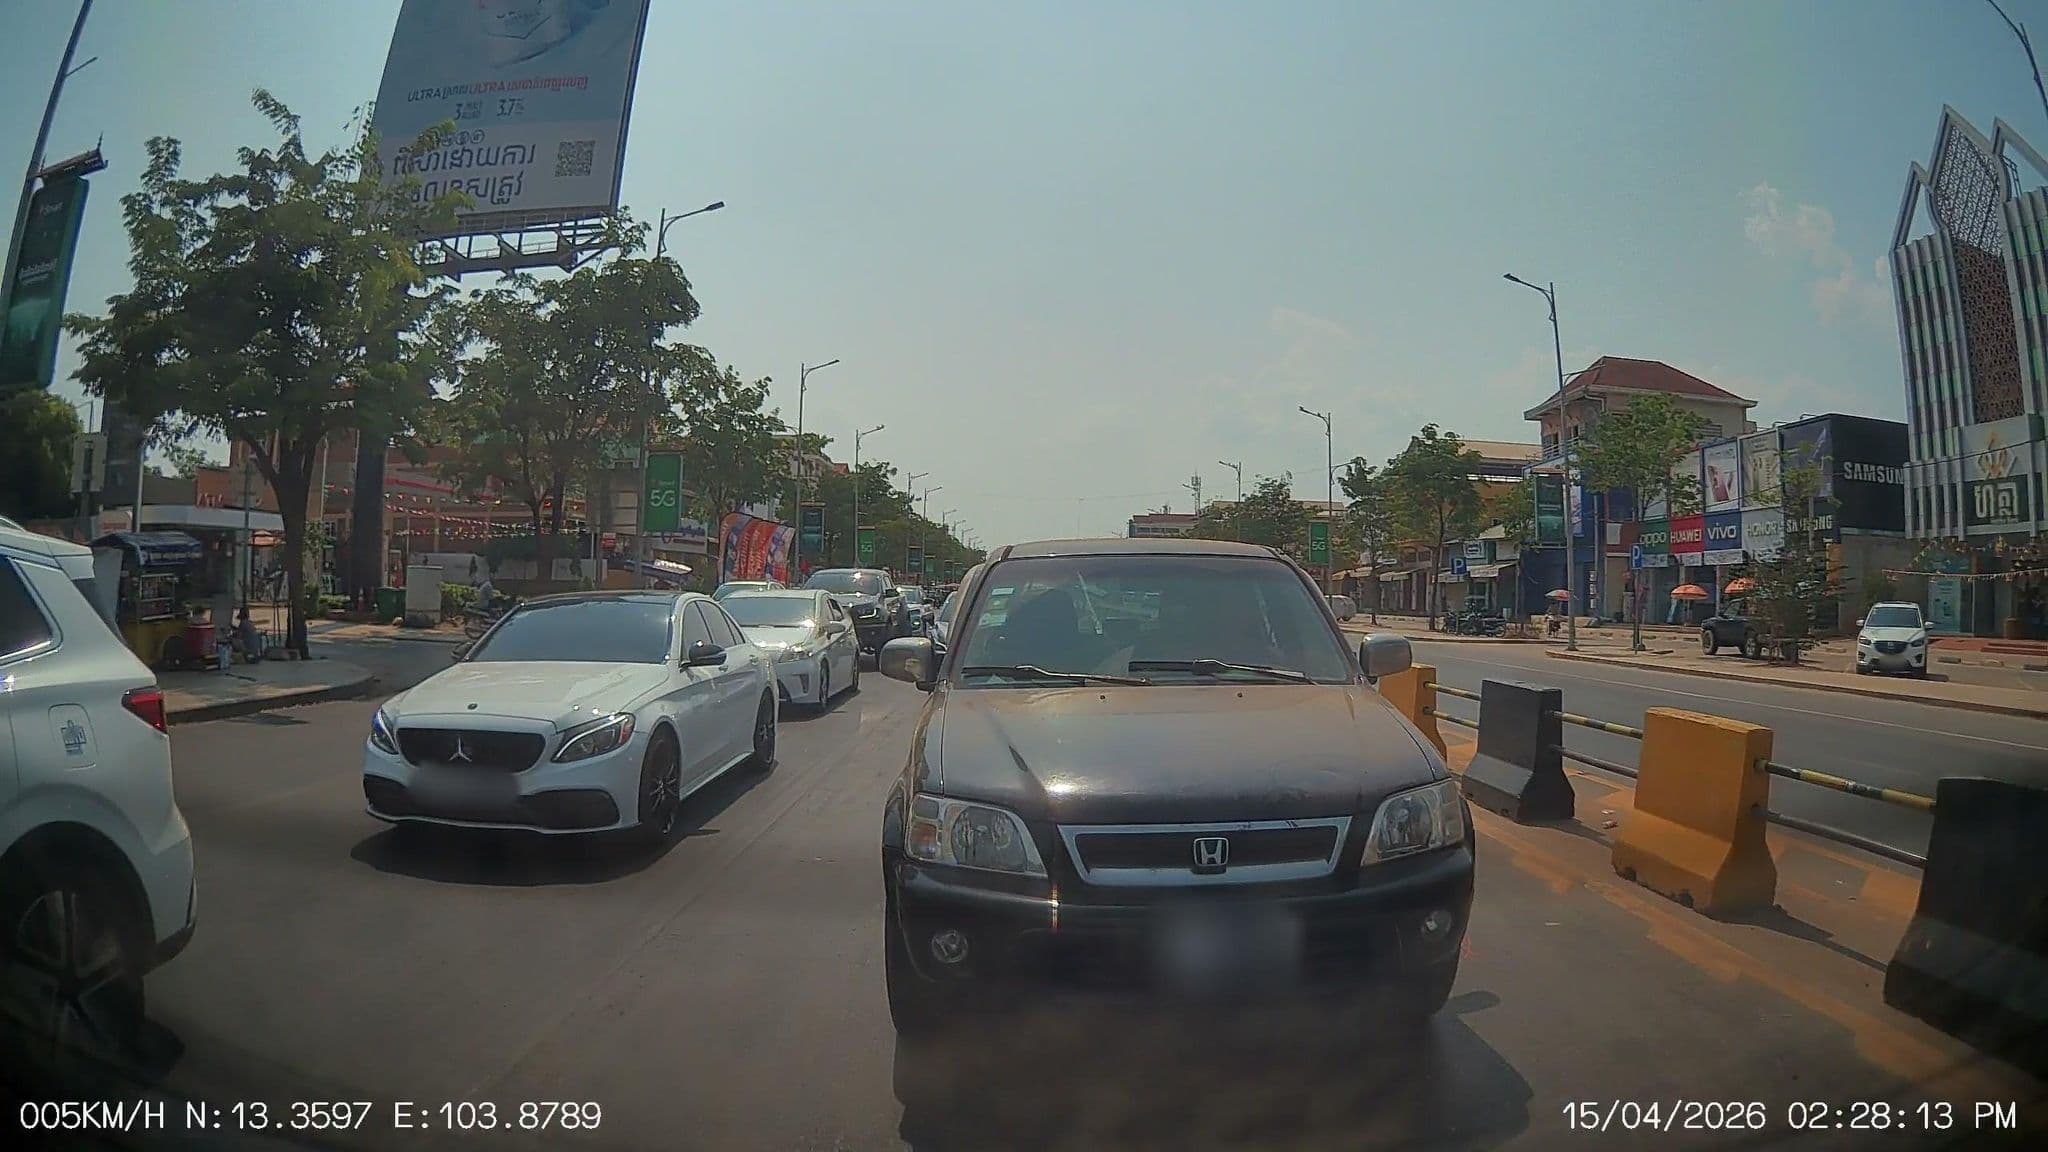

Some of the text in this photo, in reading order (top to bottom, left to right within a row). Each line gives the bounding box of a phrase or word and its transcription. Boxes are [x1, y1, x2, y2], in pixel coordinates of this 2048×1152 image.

[408, 88, 441, 102] ULTRA
[1843, 461, 1904, 485] SAMSUN
[650, 489, 676, 507] 5G
[1707, 522, 1737, 541] vivo
[1786, 514, 1833, 533] SAUNG
[1670, 529, 1702, 544] HUAWEI
[861, 543, 872, 553] 5G
[1312, 541, 1325, 551] 5G
[1454, 558, 1464, 574] P
